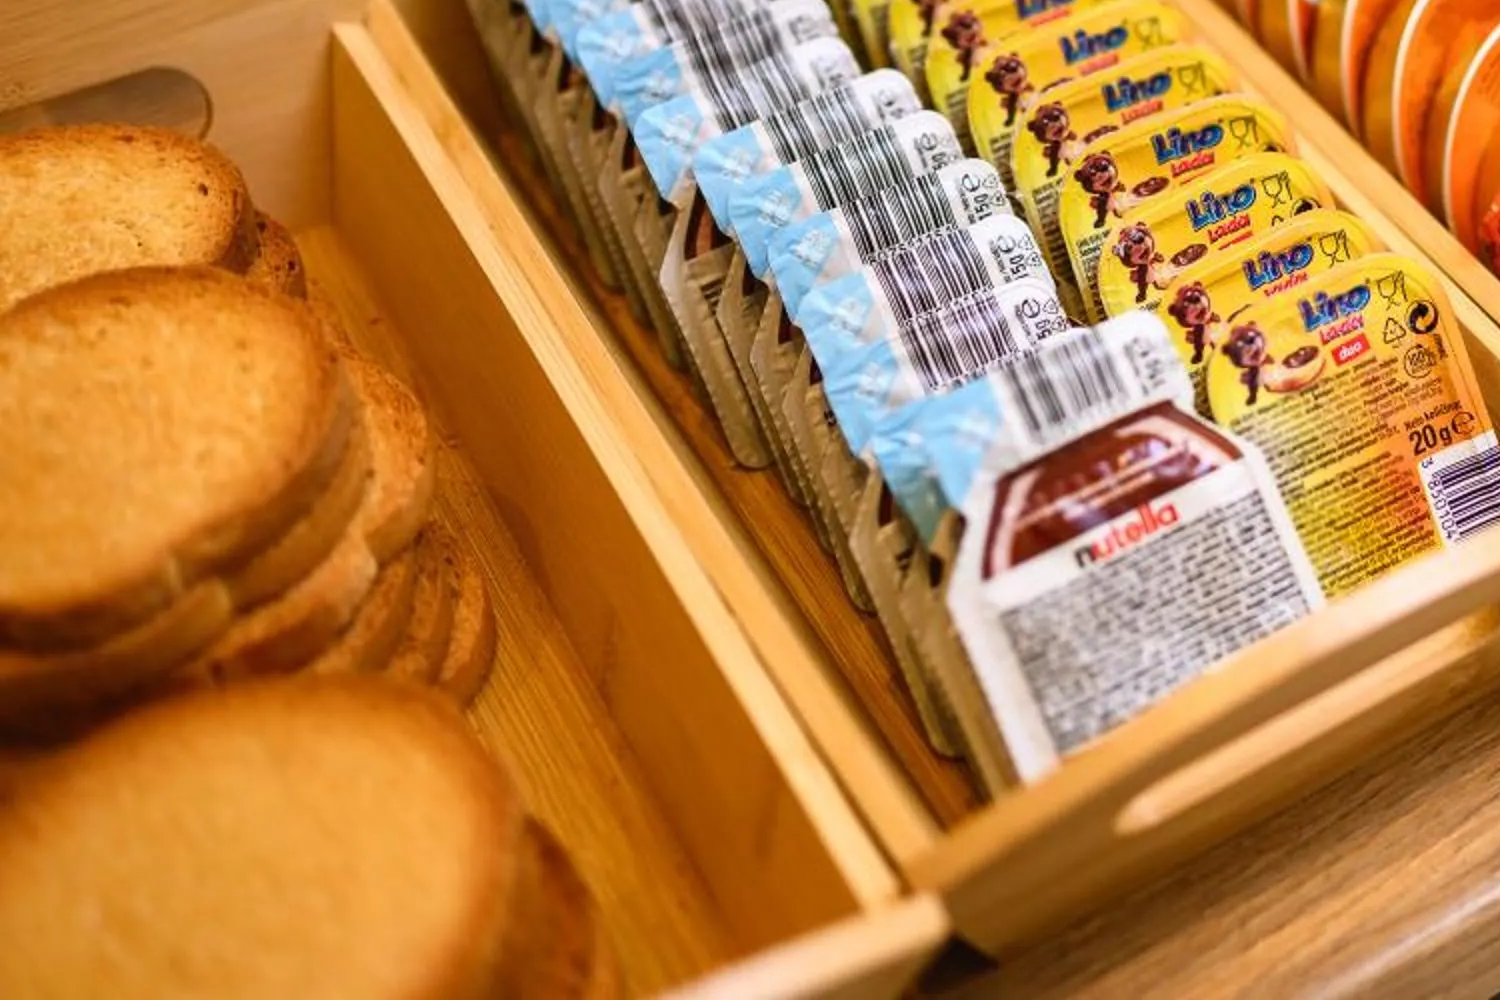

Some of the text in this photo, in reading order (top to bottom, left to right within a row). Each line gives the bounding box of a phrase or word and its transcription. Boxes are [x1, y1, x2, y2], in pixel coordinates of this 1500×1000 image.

[1059, 26, 1128, 65] Lino
[1102, 72, 1172, 112] Lino
[1151, 124, 1224, 165] Lino
[1186, 184, 1257, 232] Lino
[1242, 242, 1314, 290] Lino
[1297, 283, 1371, 333] Lino
[1074, 500, 1180, 566] nutella
